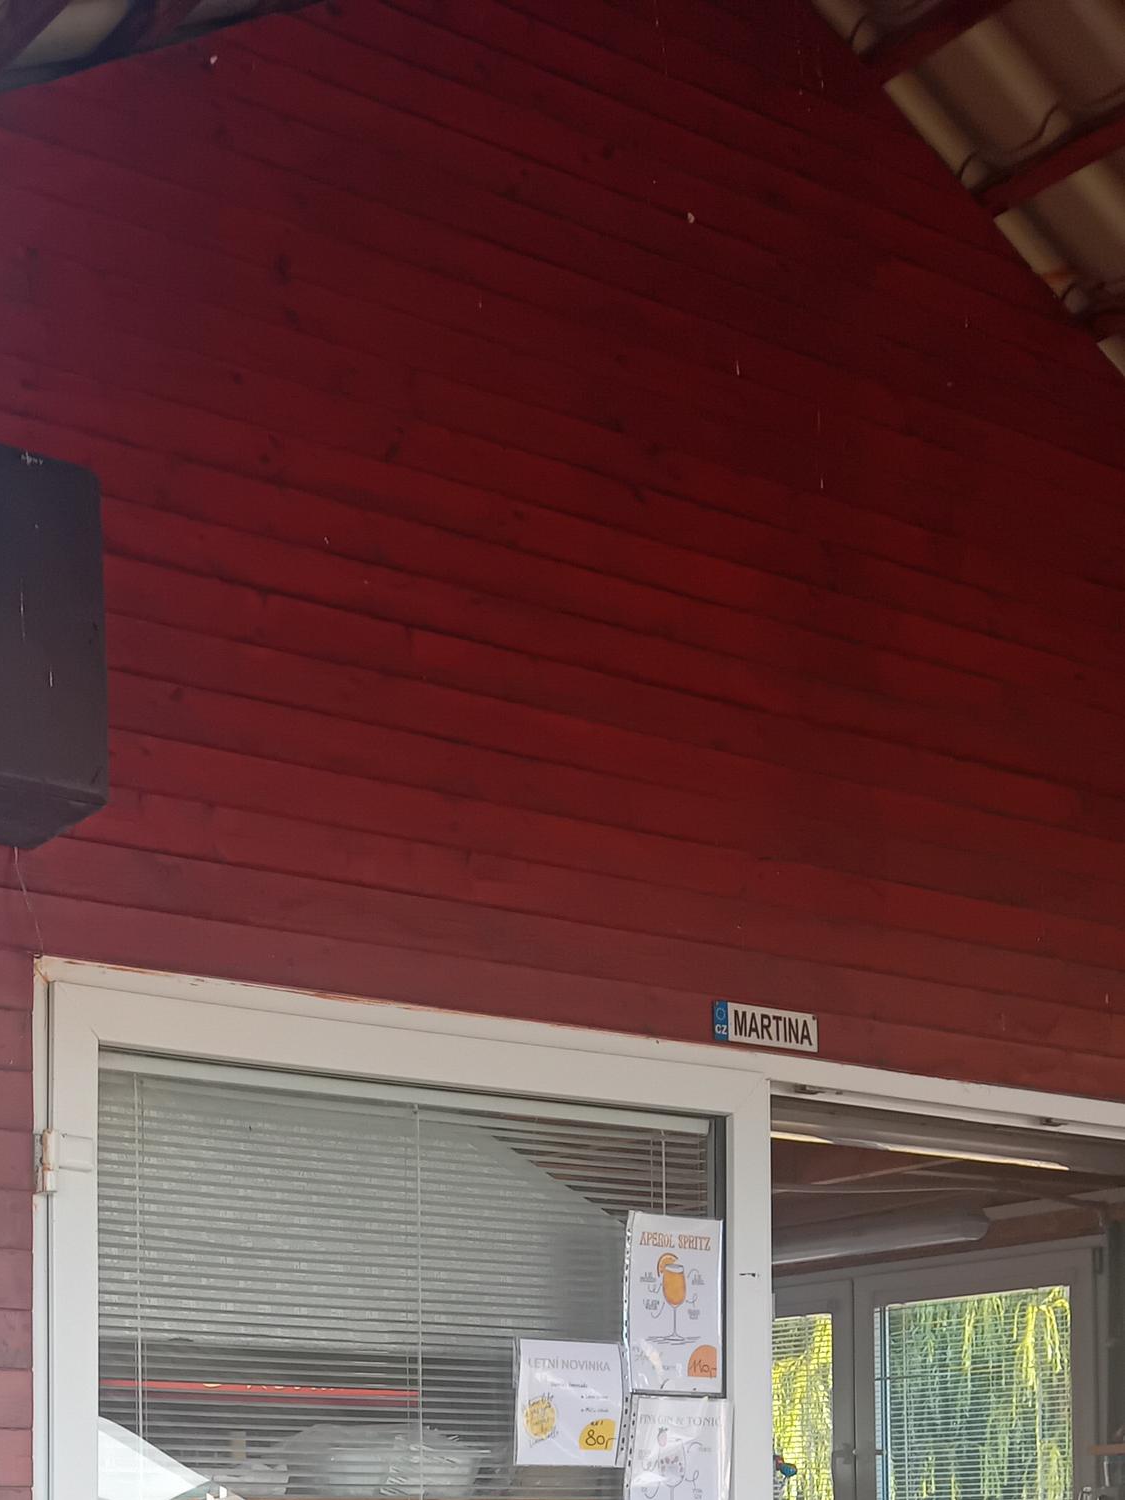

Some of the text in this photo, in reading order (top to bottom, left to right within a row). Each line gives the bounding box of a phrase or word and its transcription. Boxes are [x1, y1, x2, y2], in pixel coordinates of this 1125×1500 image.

[715, 1024, 728, 1035] CZ
[733, 1009, 813, 1046] MARTINA
[678, 1235, 712, 1251] SPRITZ
[561, 1358, 611, 1372] NOVINKA
